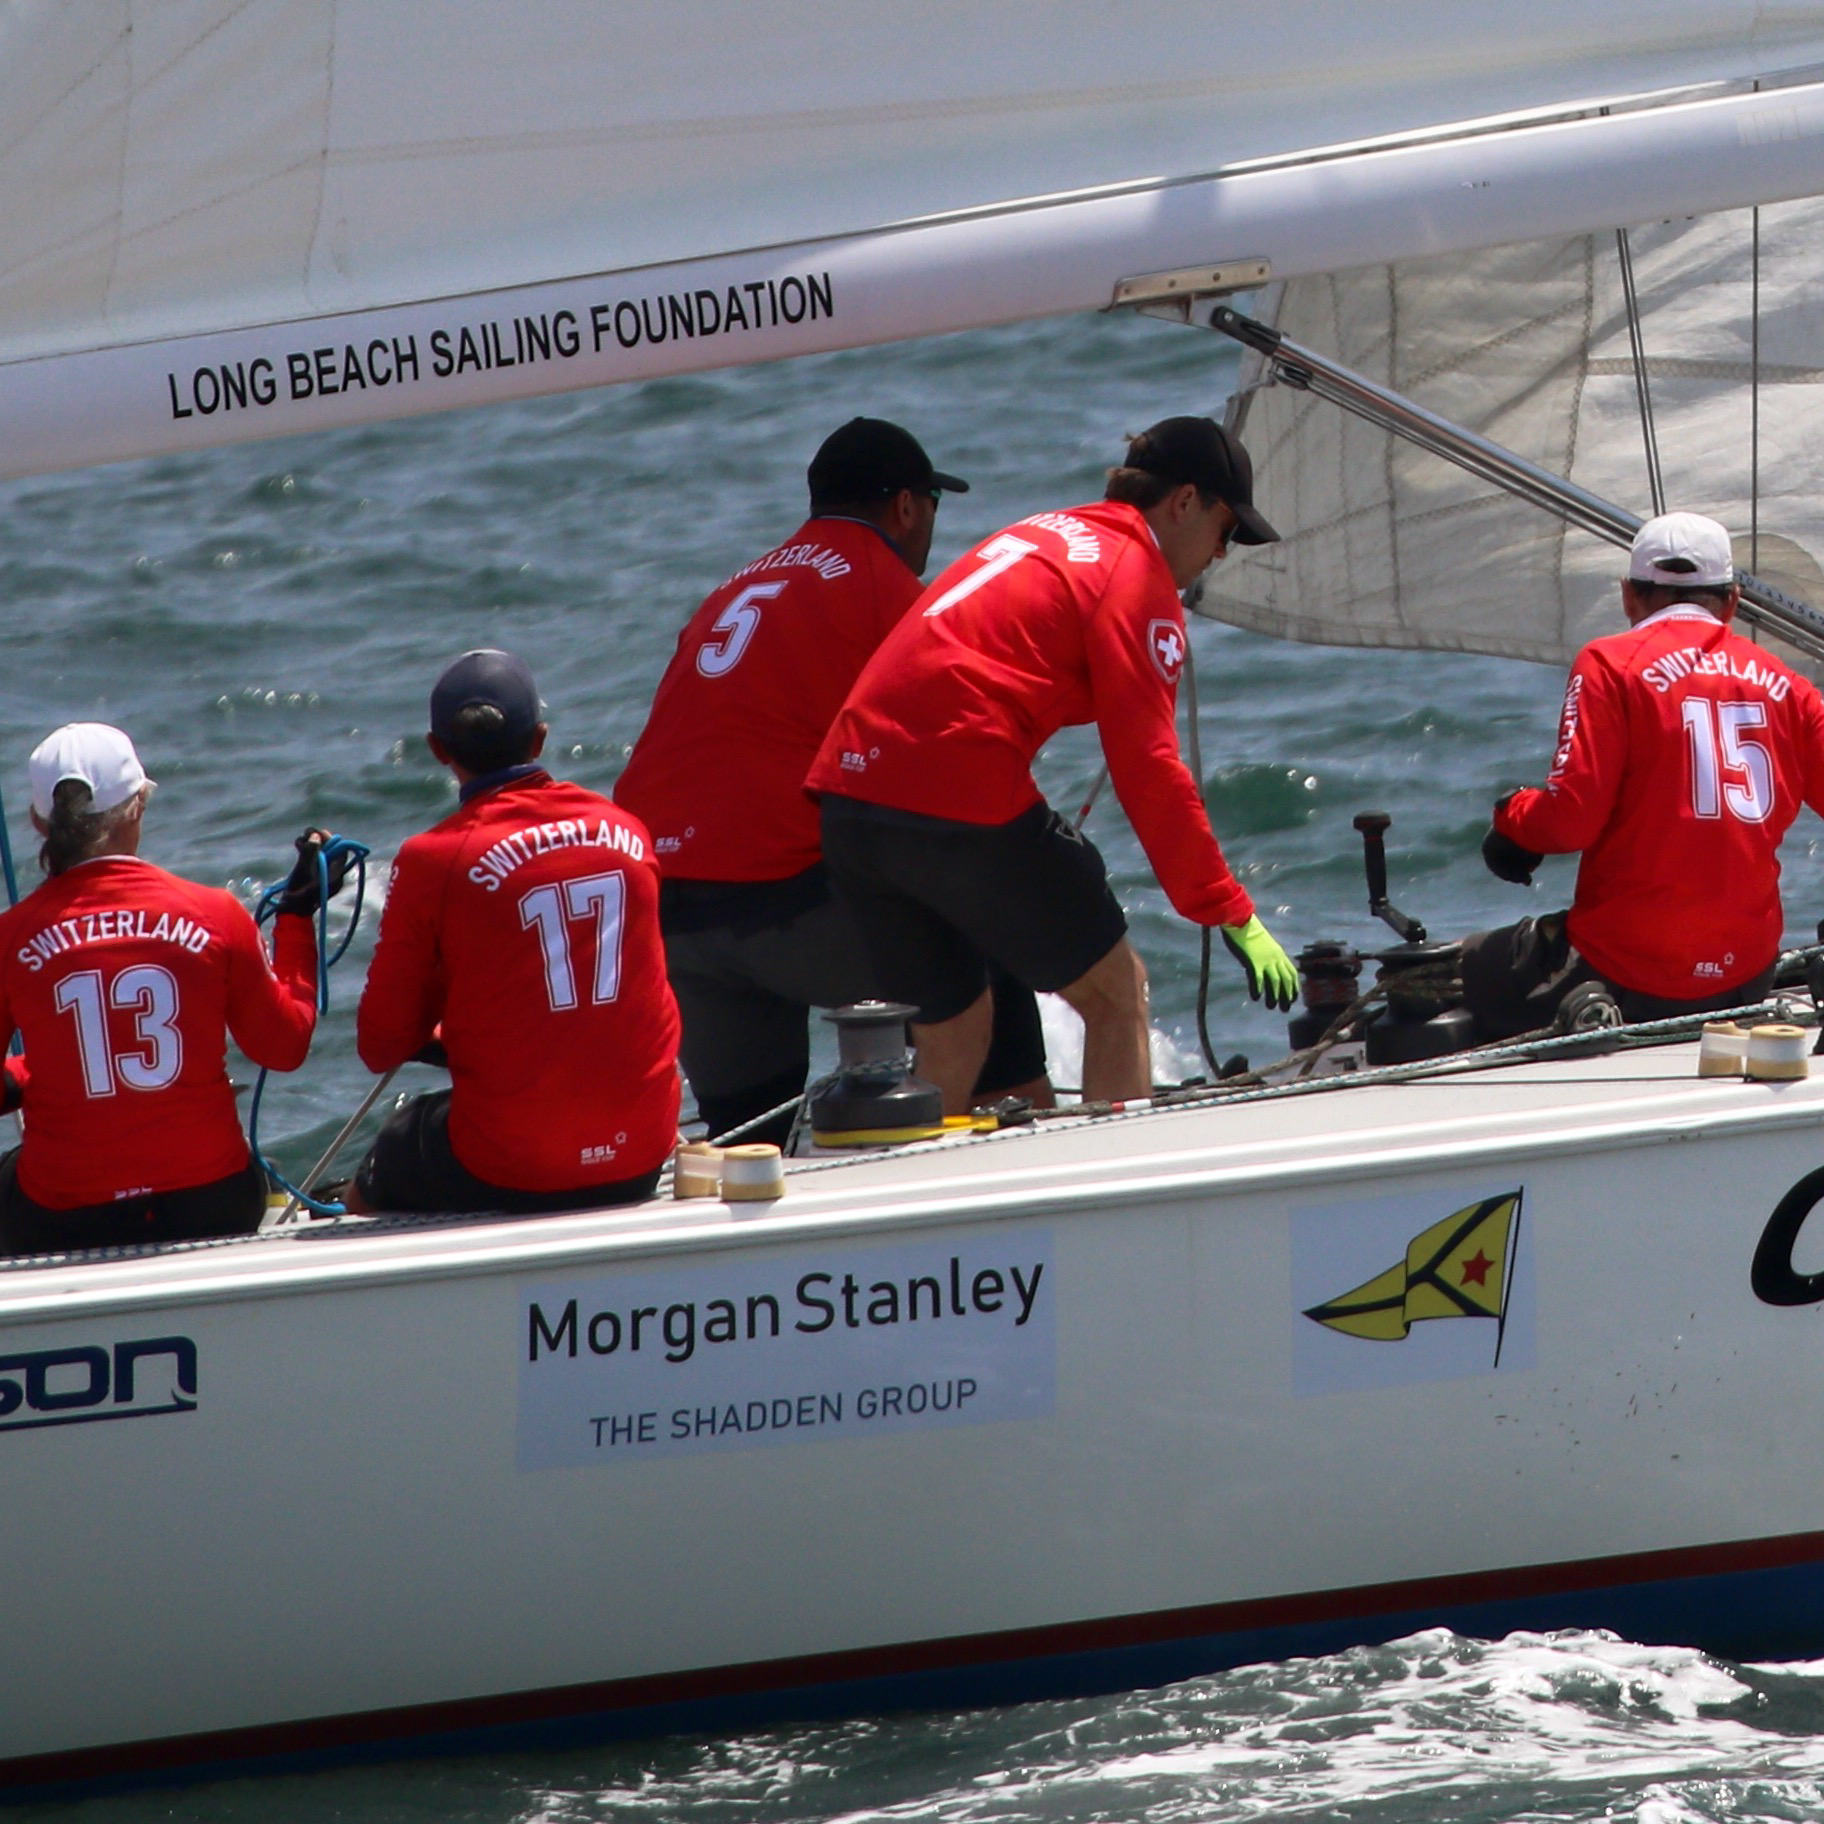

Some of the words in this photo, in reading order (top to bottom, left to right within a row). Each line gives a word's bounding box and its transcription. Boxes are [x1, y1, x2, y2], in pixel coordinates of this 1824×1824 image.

[170, 359, 277, 418] LONG
[290, 334, 420, 400] BEACH
[432, 309, 580, 378] SAILING
[591, 273, 834, 352] FOUNDATION
[922, 533, 1039, 616] 7
[696, 580, 789, 677] 5
[1682, 696, 1775, 823] 15
[468, 819, 644, 892] SWITZERLAND
[18, 911, 210, 972] SWITZERLAND
[518, 869, 626, 1012] 17
[54, 964, 182, 1099] 13
[527, 1284, 780, 1364] Morgan
[795, 1256, 1043, 1334] Stanley
[589, 1412, 656, 1447] THE
[670, 1394, 842, 1440] SHADDEN
[857, 1378, 978, 1424] GROUP
